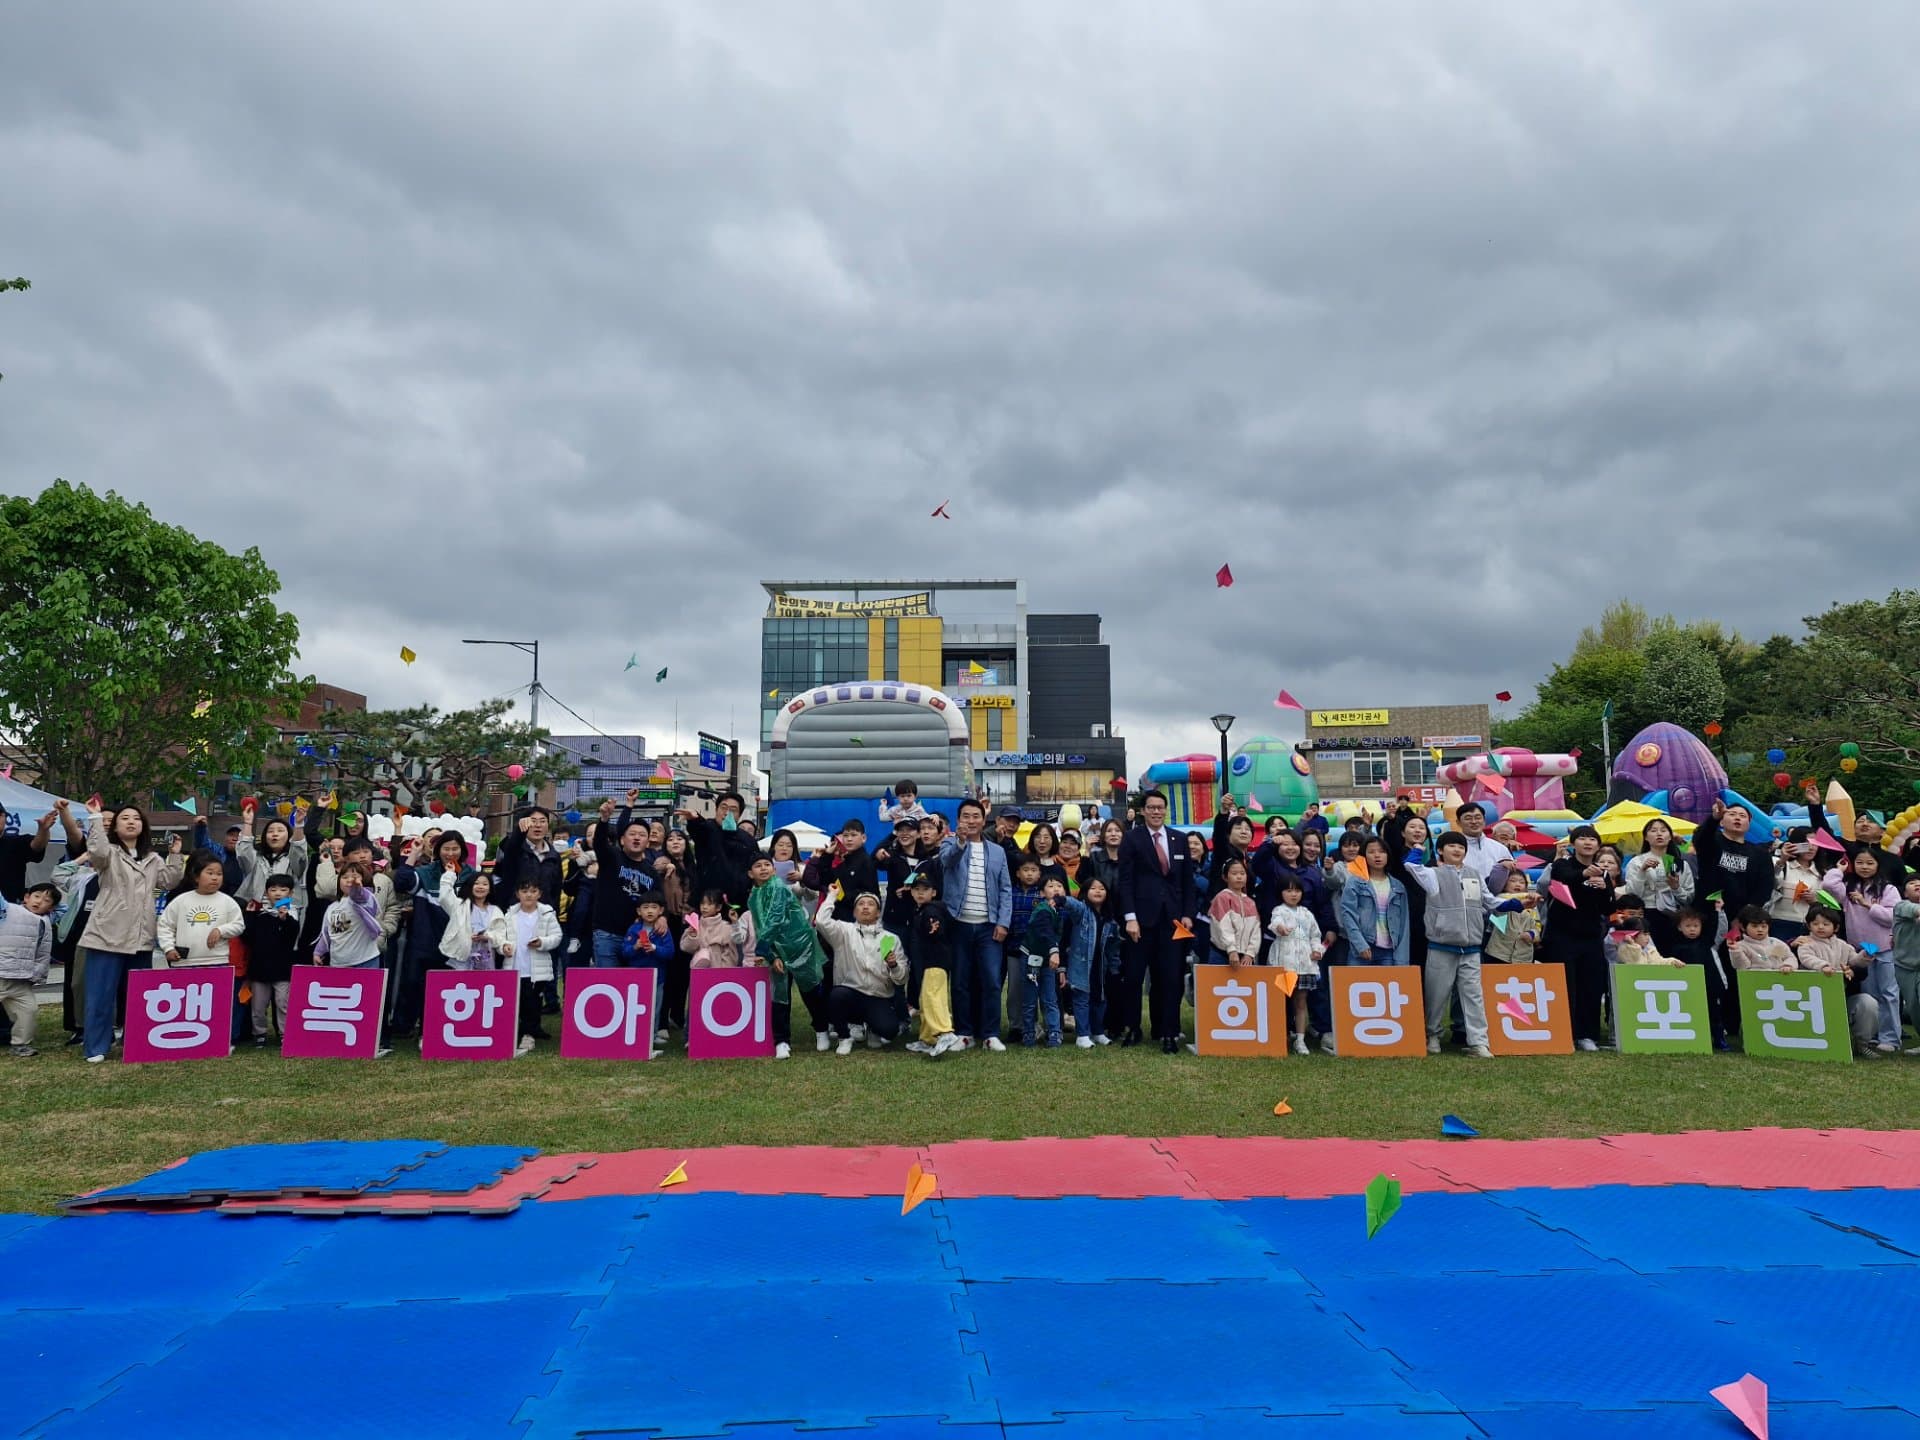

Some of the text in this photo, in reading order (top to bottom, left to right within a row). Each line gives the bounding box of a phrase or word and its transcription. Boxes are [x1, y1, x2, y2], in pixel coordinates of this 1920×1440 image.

[970, 694, 1012, 708] 한의원
[1361, 735, 1413, 747] 엔지니어링
[144, 982, 766, 1048] 행 복 한 아 이
[1211, 977, 1555, 1045] 희 망 찬
[1634, 980, 1828, 1049] 포 천
